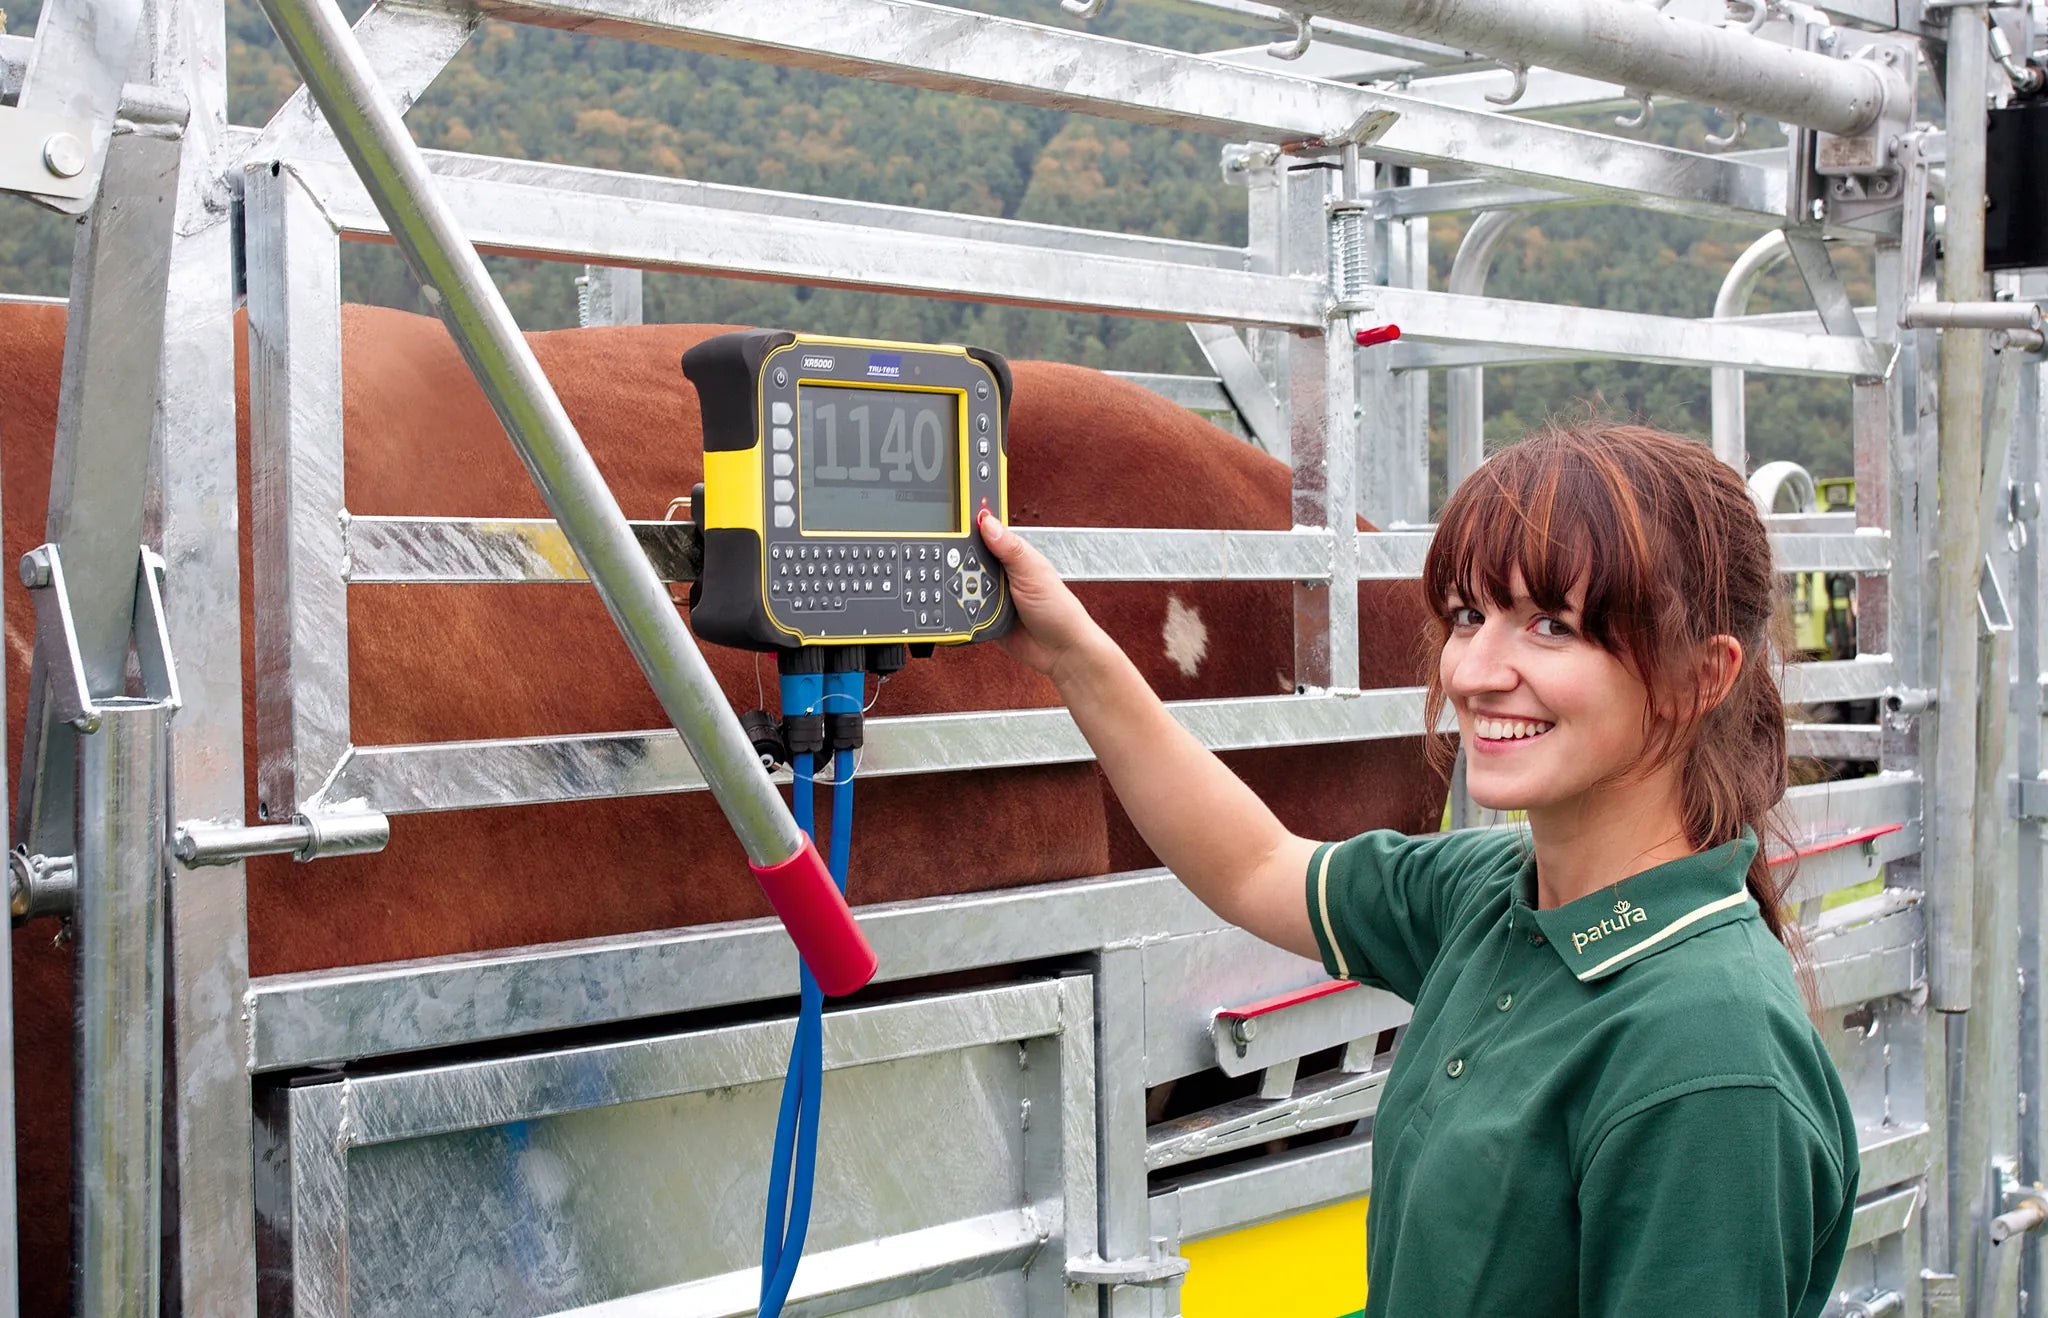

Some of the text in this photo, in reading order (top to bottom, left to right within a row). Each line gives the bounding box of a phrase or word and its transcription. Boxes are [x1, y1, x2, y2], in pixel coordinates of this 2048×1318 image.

[803, 358, 833, 369] XR5000
[815, 404, 943, 482] 1140
[905, 548, 940, 559] 1 2 3
[905, 570, 940, 581] 4 5 6
[906, 591, 940, 603] 7 8 9
[920, 613, 926, 624] 0
[1571, 907, 1647, 955] patura
